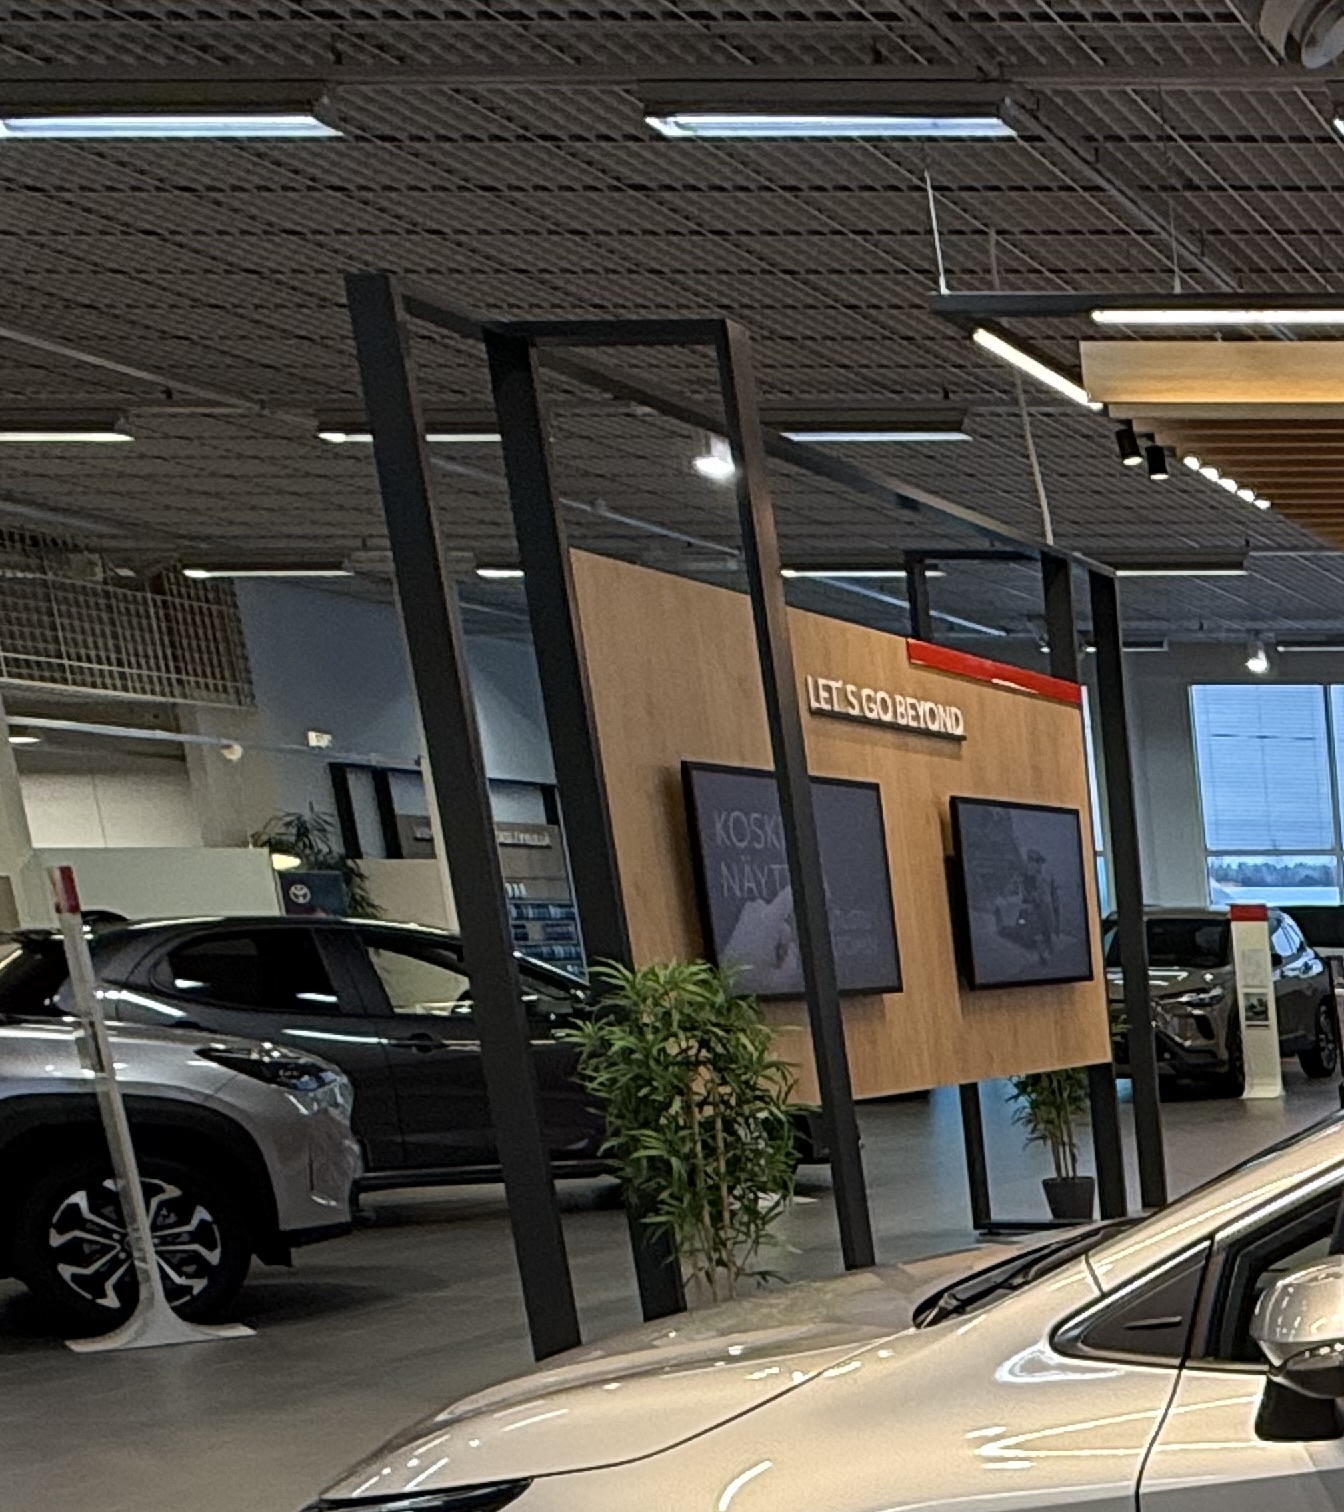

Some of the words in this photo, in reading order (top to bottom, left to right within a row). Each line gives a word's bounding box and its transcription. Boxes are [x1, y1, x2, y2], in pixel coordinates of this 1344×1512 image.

[861, 688, 894, 721] GO
[895, 694, 964, 736] BEYOND
[714, 810, 786, 849] KOSK
